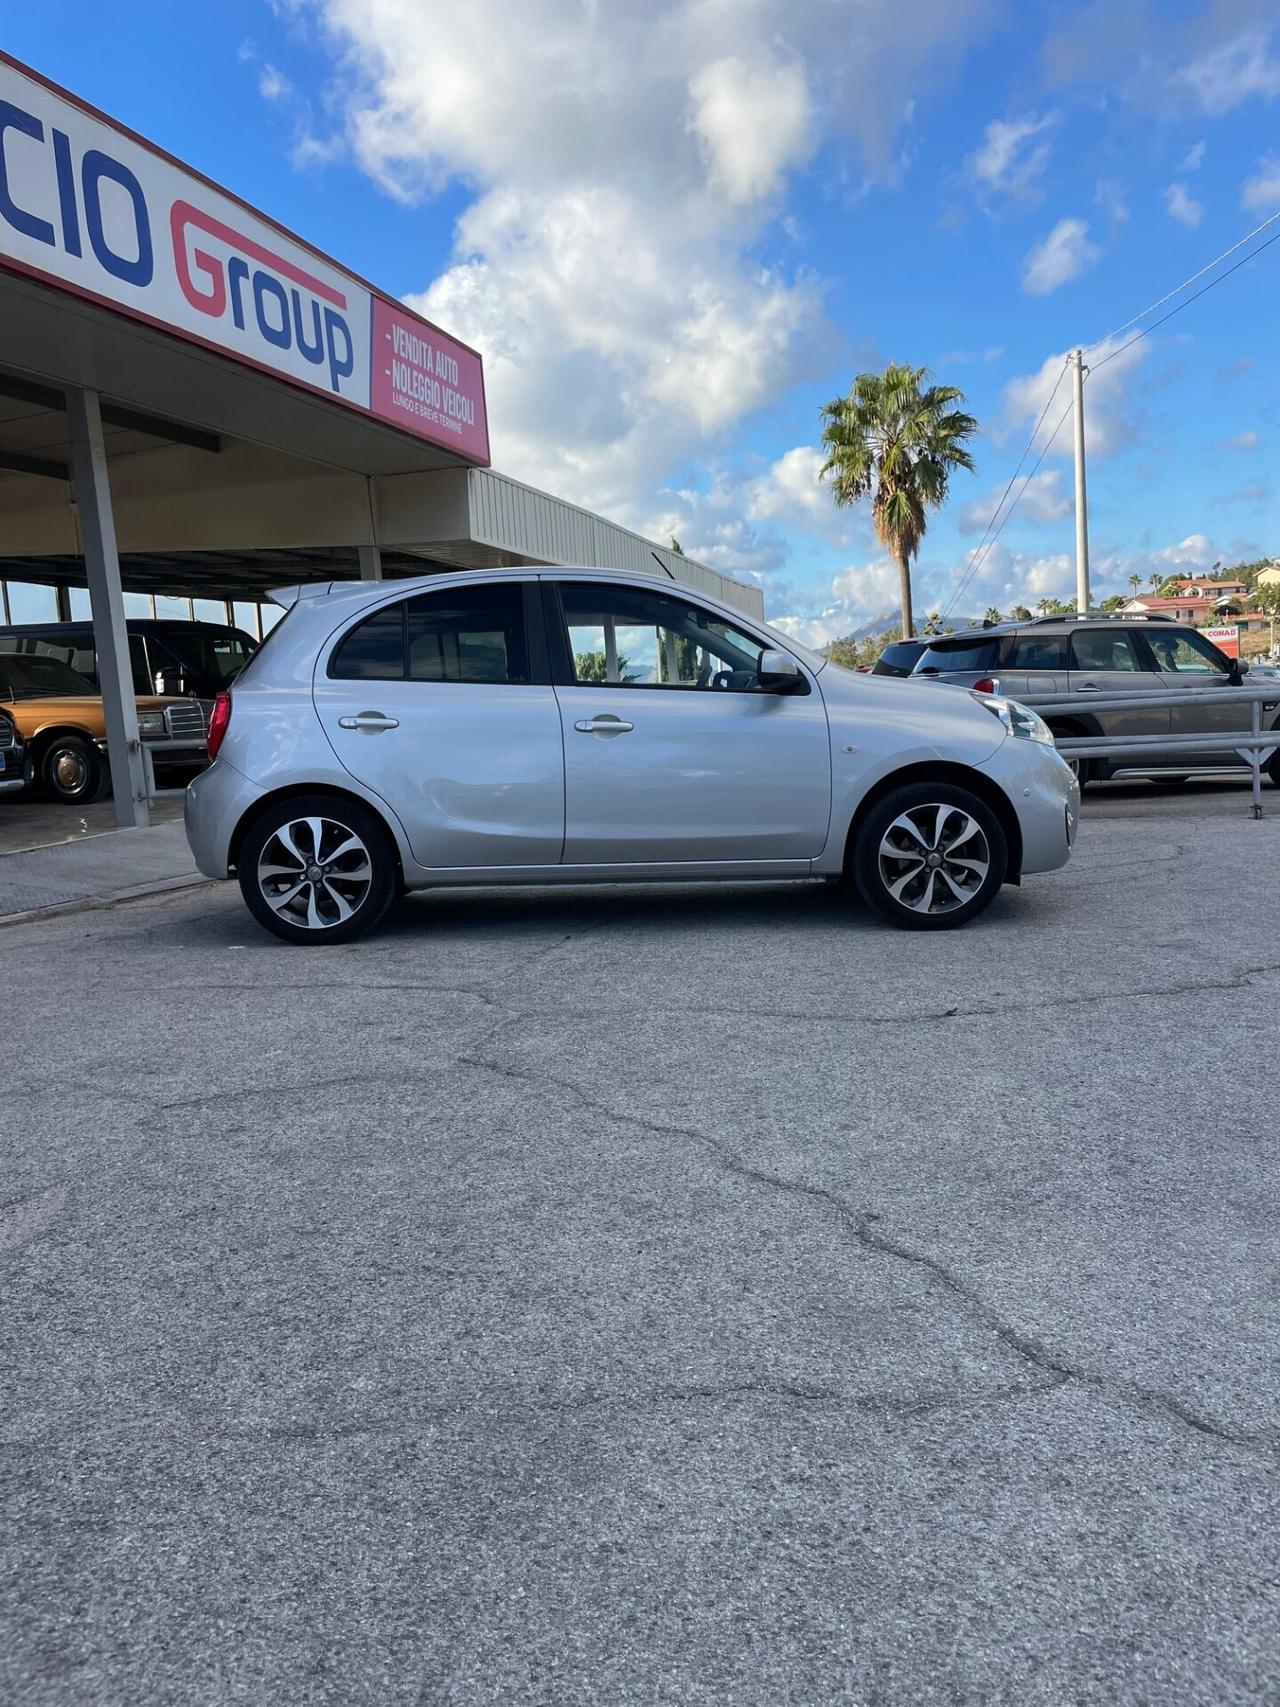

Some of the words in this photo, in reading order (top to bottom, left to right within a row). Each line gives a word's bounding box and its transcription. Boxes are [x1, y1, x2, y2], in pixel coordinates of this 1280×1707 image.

[170, 200, 354, 393] Group
[436, 350, 459, 387] AUTO
[392, 391, 414, 412] LUNGO
[414, 402, 419, 415] E
[420, 404, 439, 424] BREVE
[439, 413, 463, 434] TERMINE
[442, 385, 475, 426] VEICOLI
